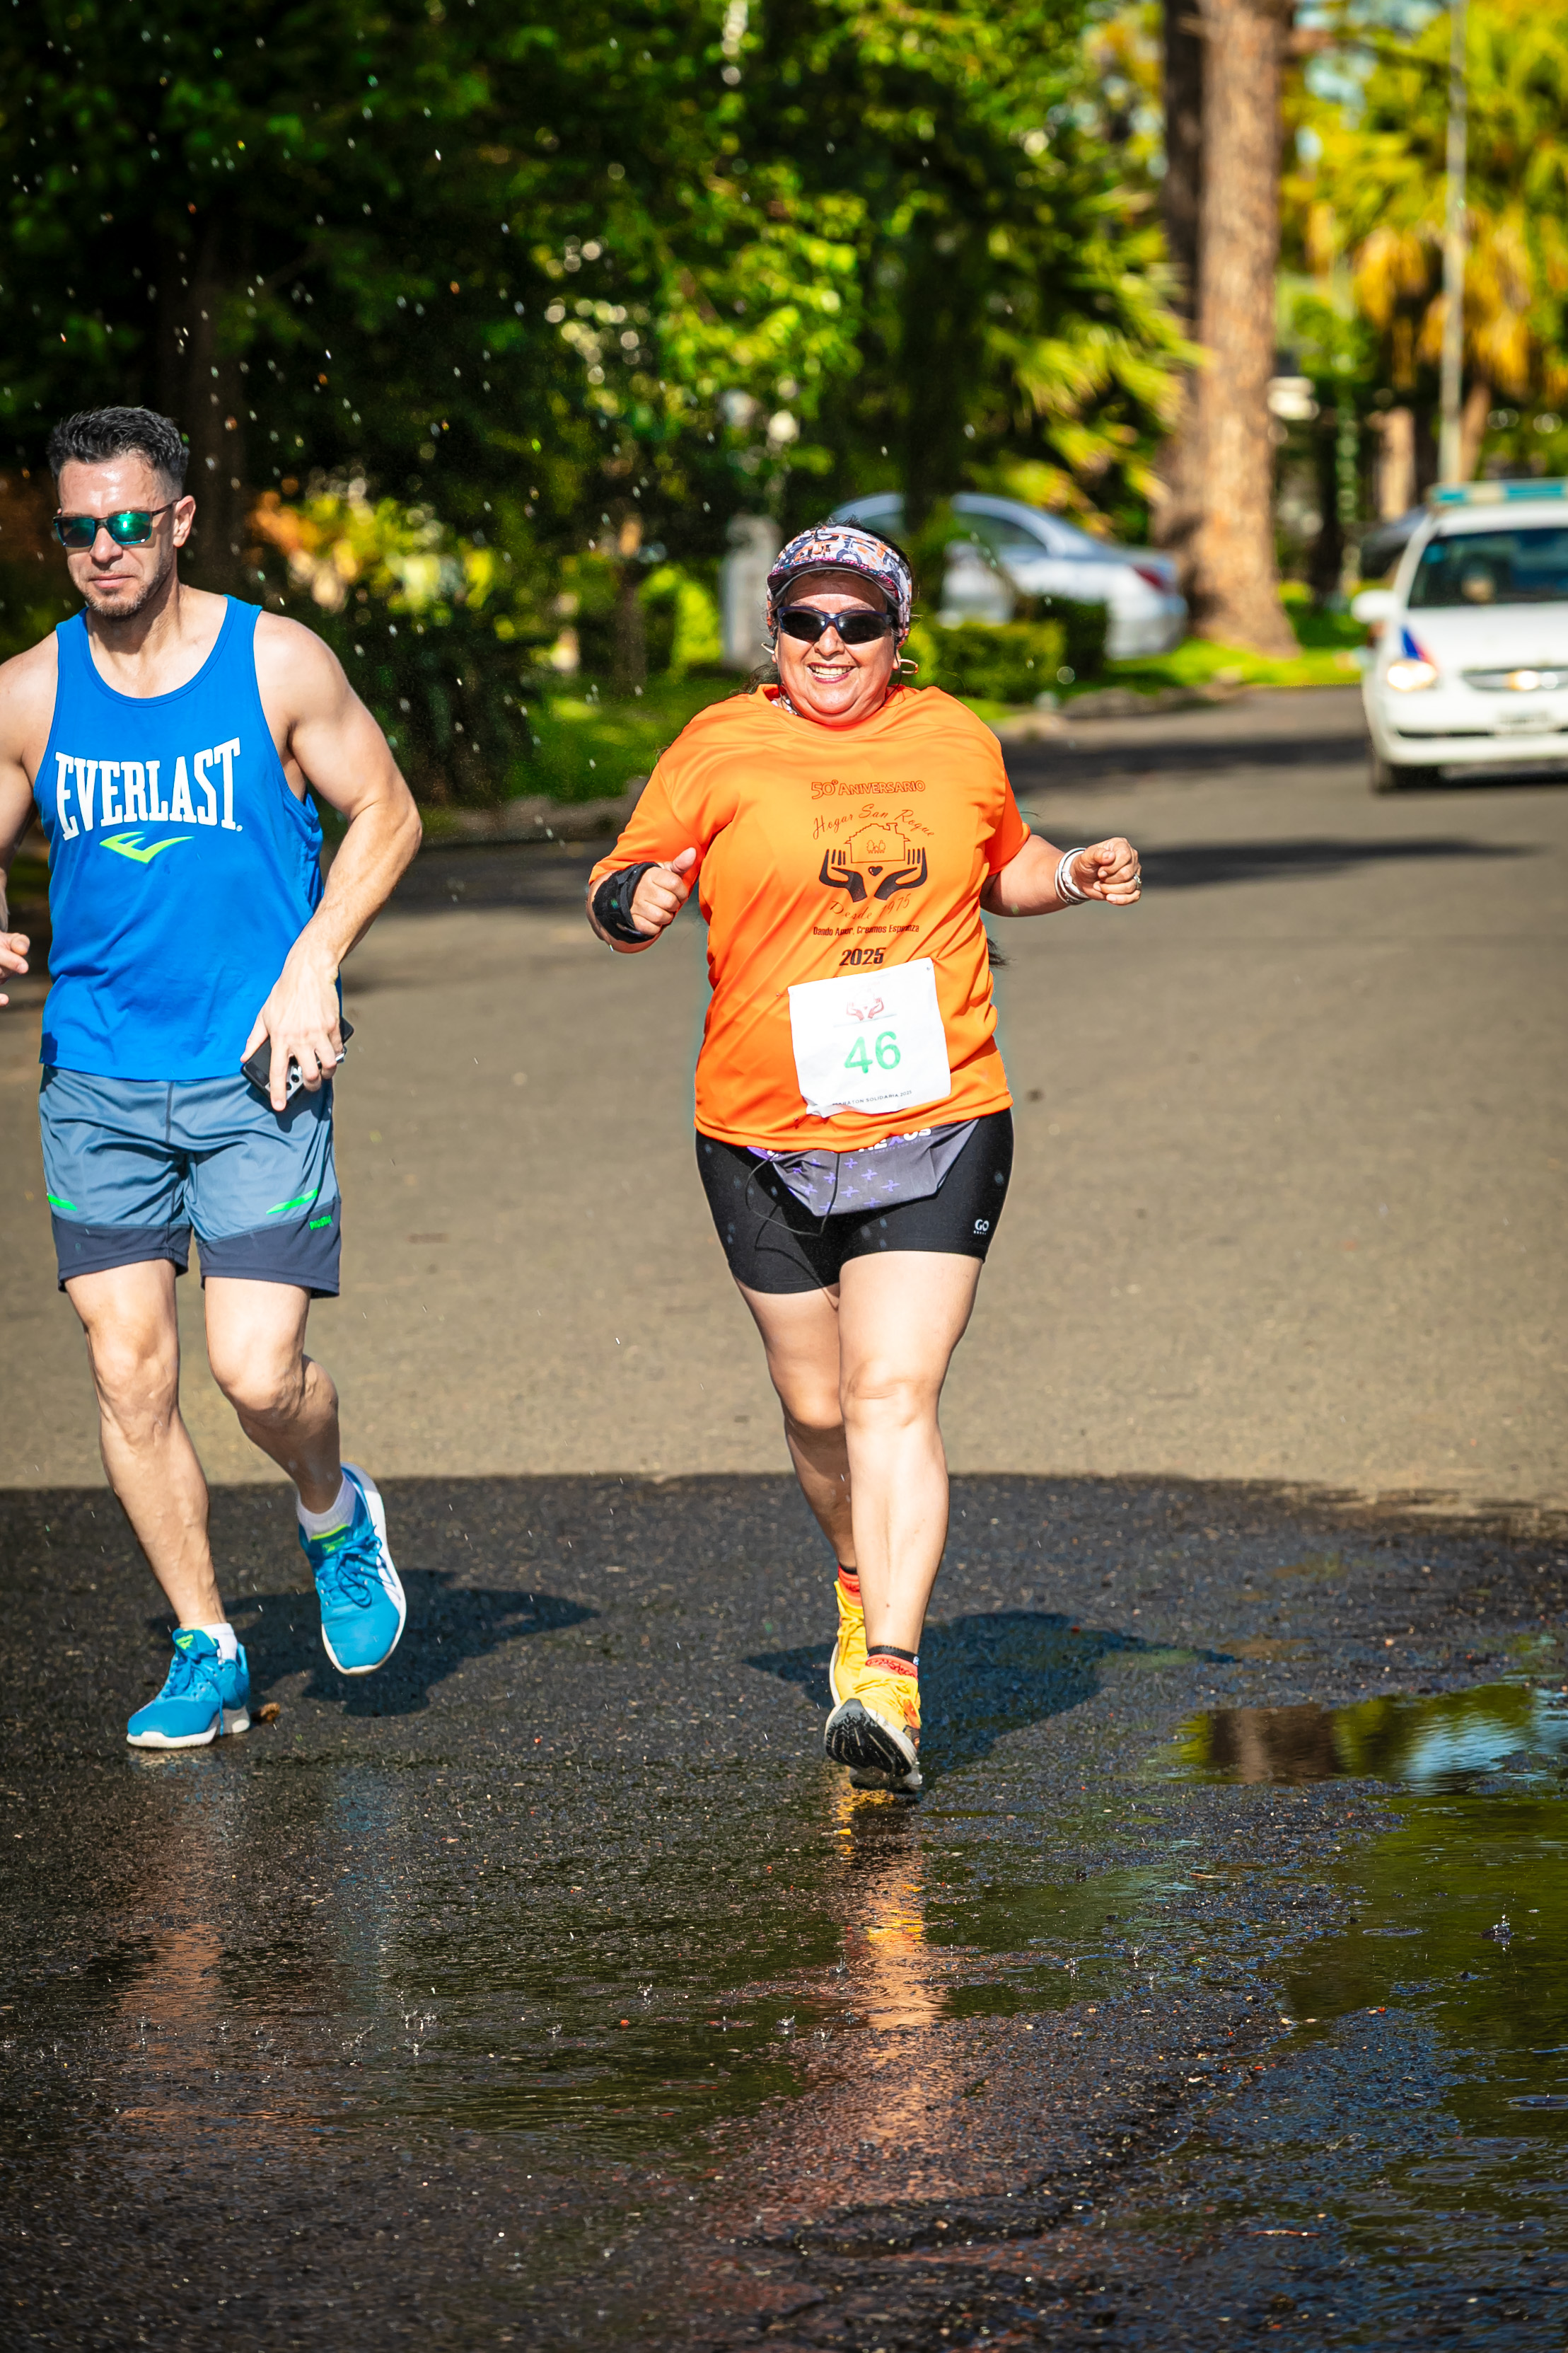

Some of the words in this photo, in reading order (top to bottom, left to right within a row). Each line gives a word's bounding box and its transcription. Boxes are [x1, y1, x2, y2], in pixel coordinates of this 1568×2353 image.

[55, 736, 241, 840] EVERLAST
[838, 780, 926, 796] ANIVERSARIO
[813, 814, 853, 840] Hogar
[858, 803, 889, 819] San
[894, 809, 935, 838] Roque
[830, 900, 872, 920] Desde
[878, 893, 912, 918] 1975
[813, 926, 833, 936] Dando
[856, 925, 887, 934] Creamos
[888, 924, 919, 933] Esperanza
[839, 947, 887, 966] 2025
[844, 1031, 901, 1074] 46
[866, 1094, 899, 1103] SOLIDARIA
